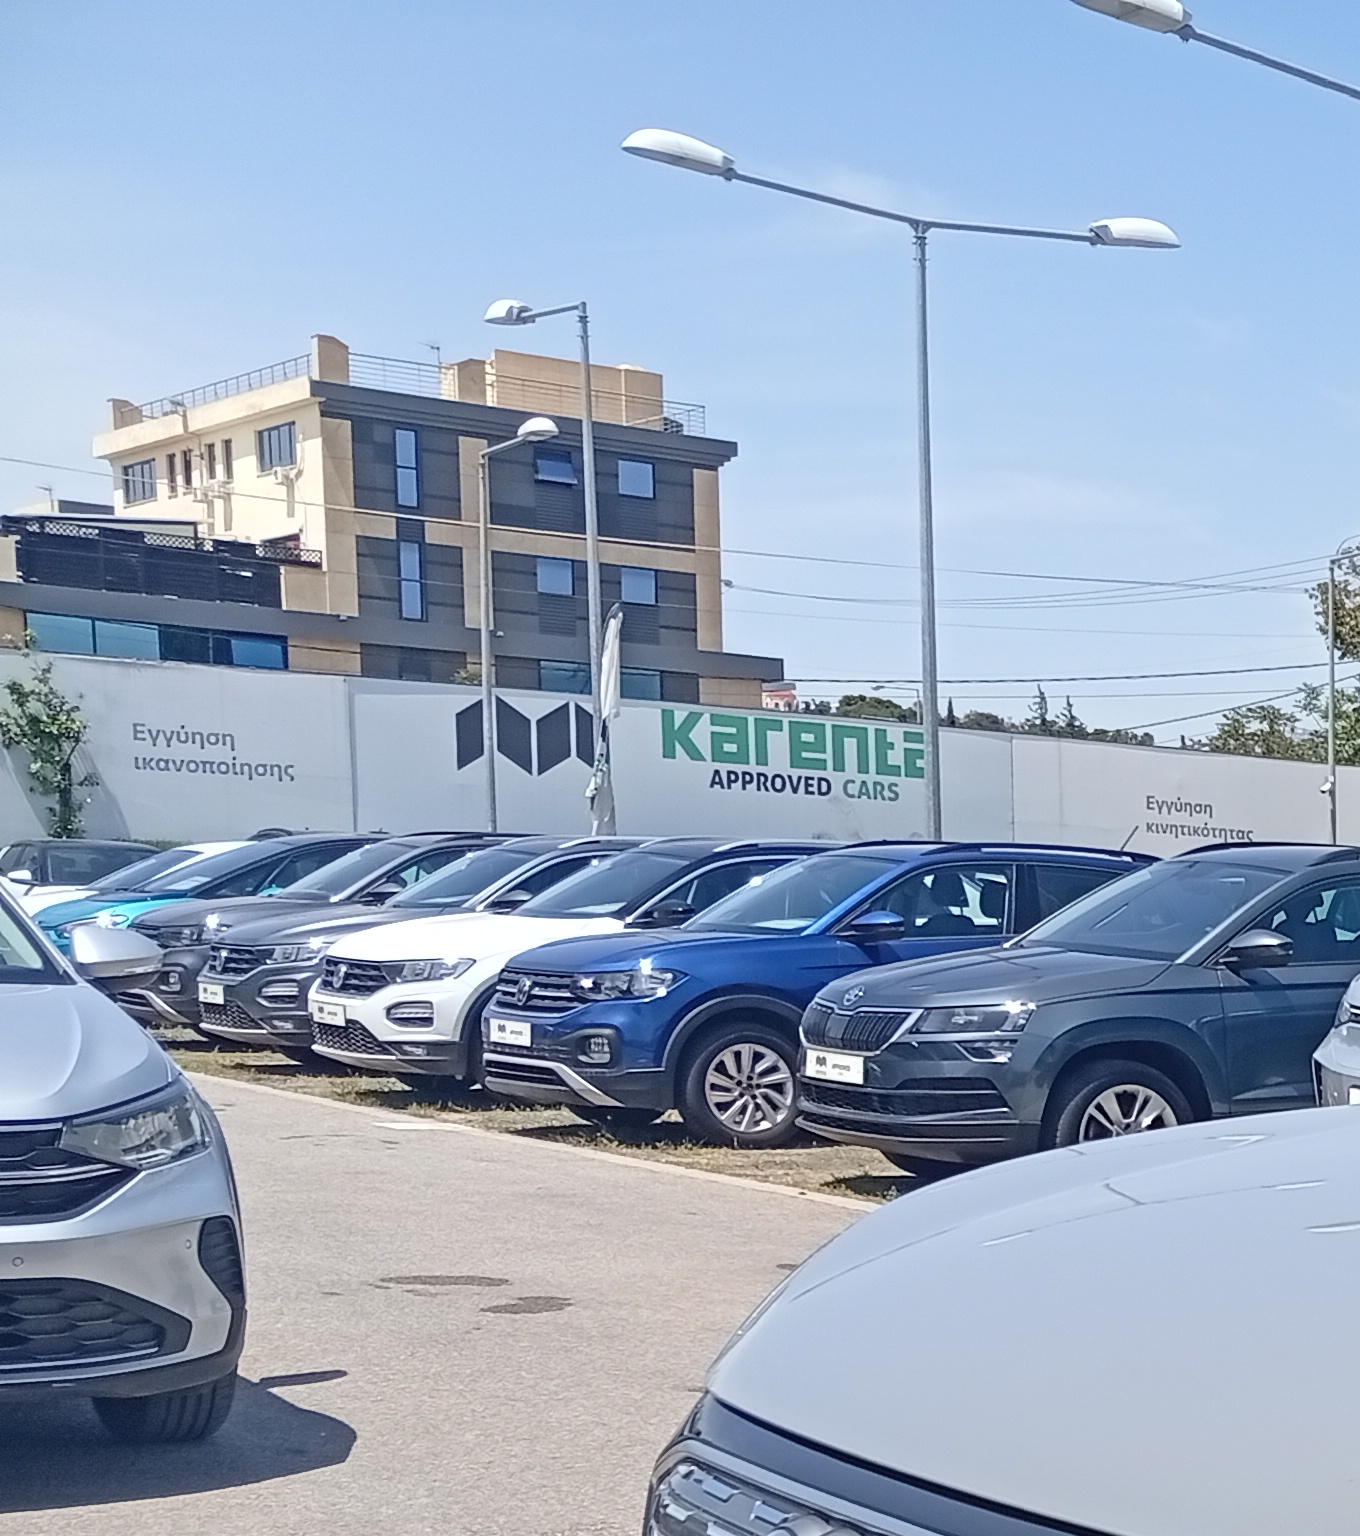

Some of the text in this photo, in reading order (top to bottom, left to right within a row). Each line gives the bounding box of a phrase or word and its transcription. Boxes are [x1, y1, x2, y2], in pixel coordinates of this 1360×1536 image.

[132, 722, 236, 751] Εγγύηση
[134, 756, 296, 782] ικανοποίησης
[709, 769, 900, 801] APPROVED CARS
[1146, 795, 1213, 818] Εγγύηση
[1146, 822, 1254, 842] κινητικότητας
